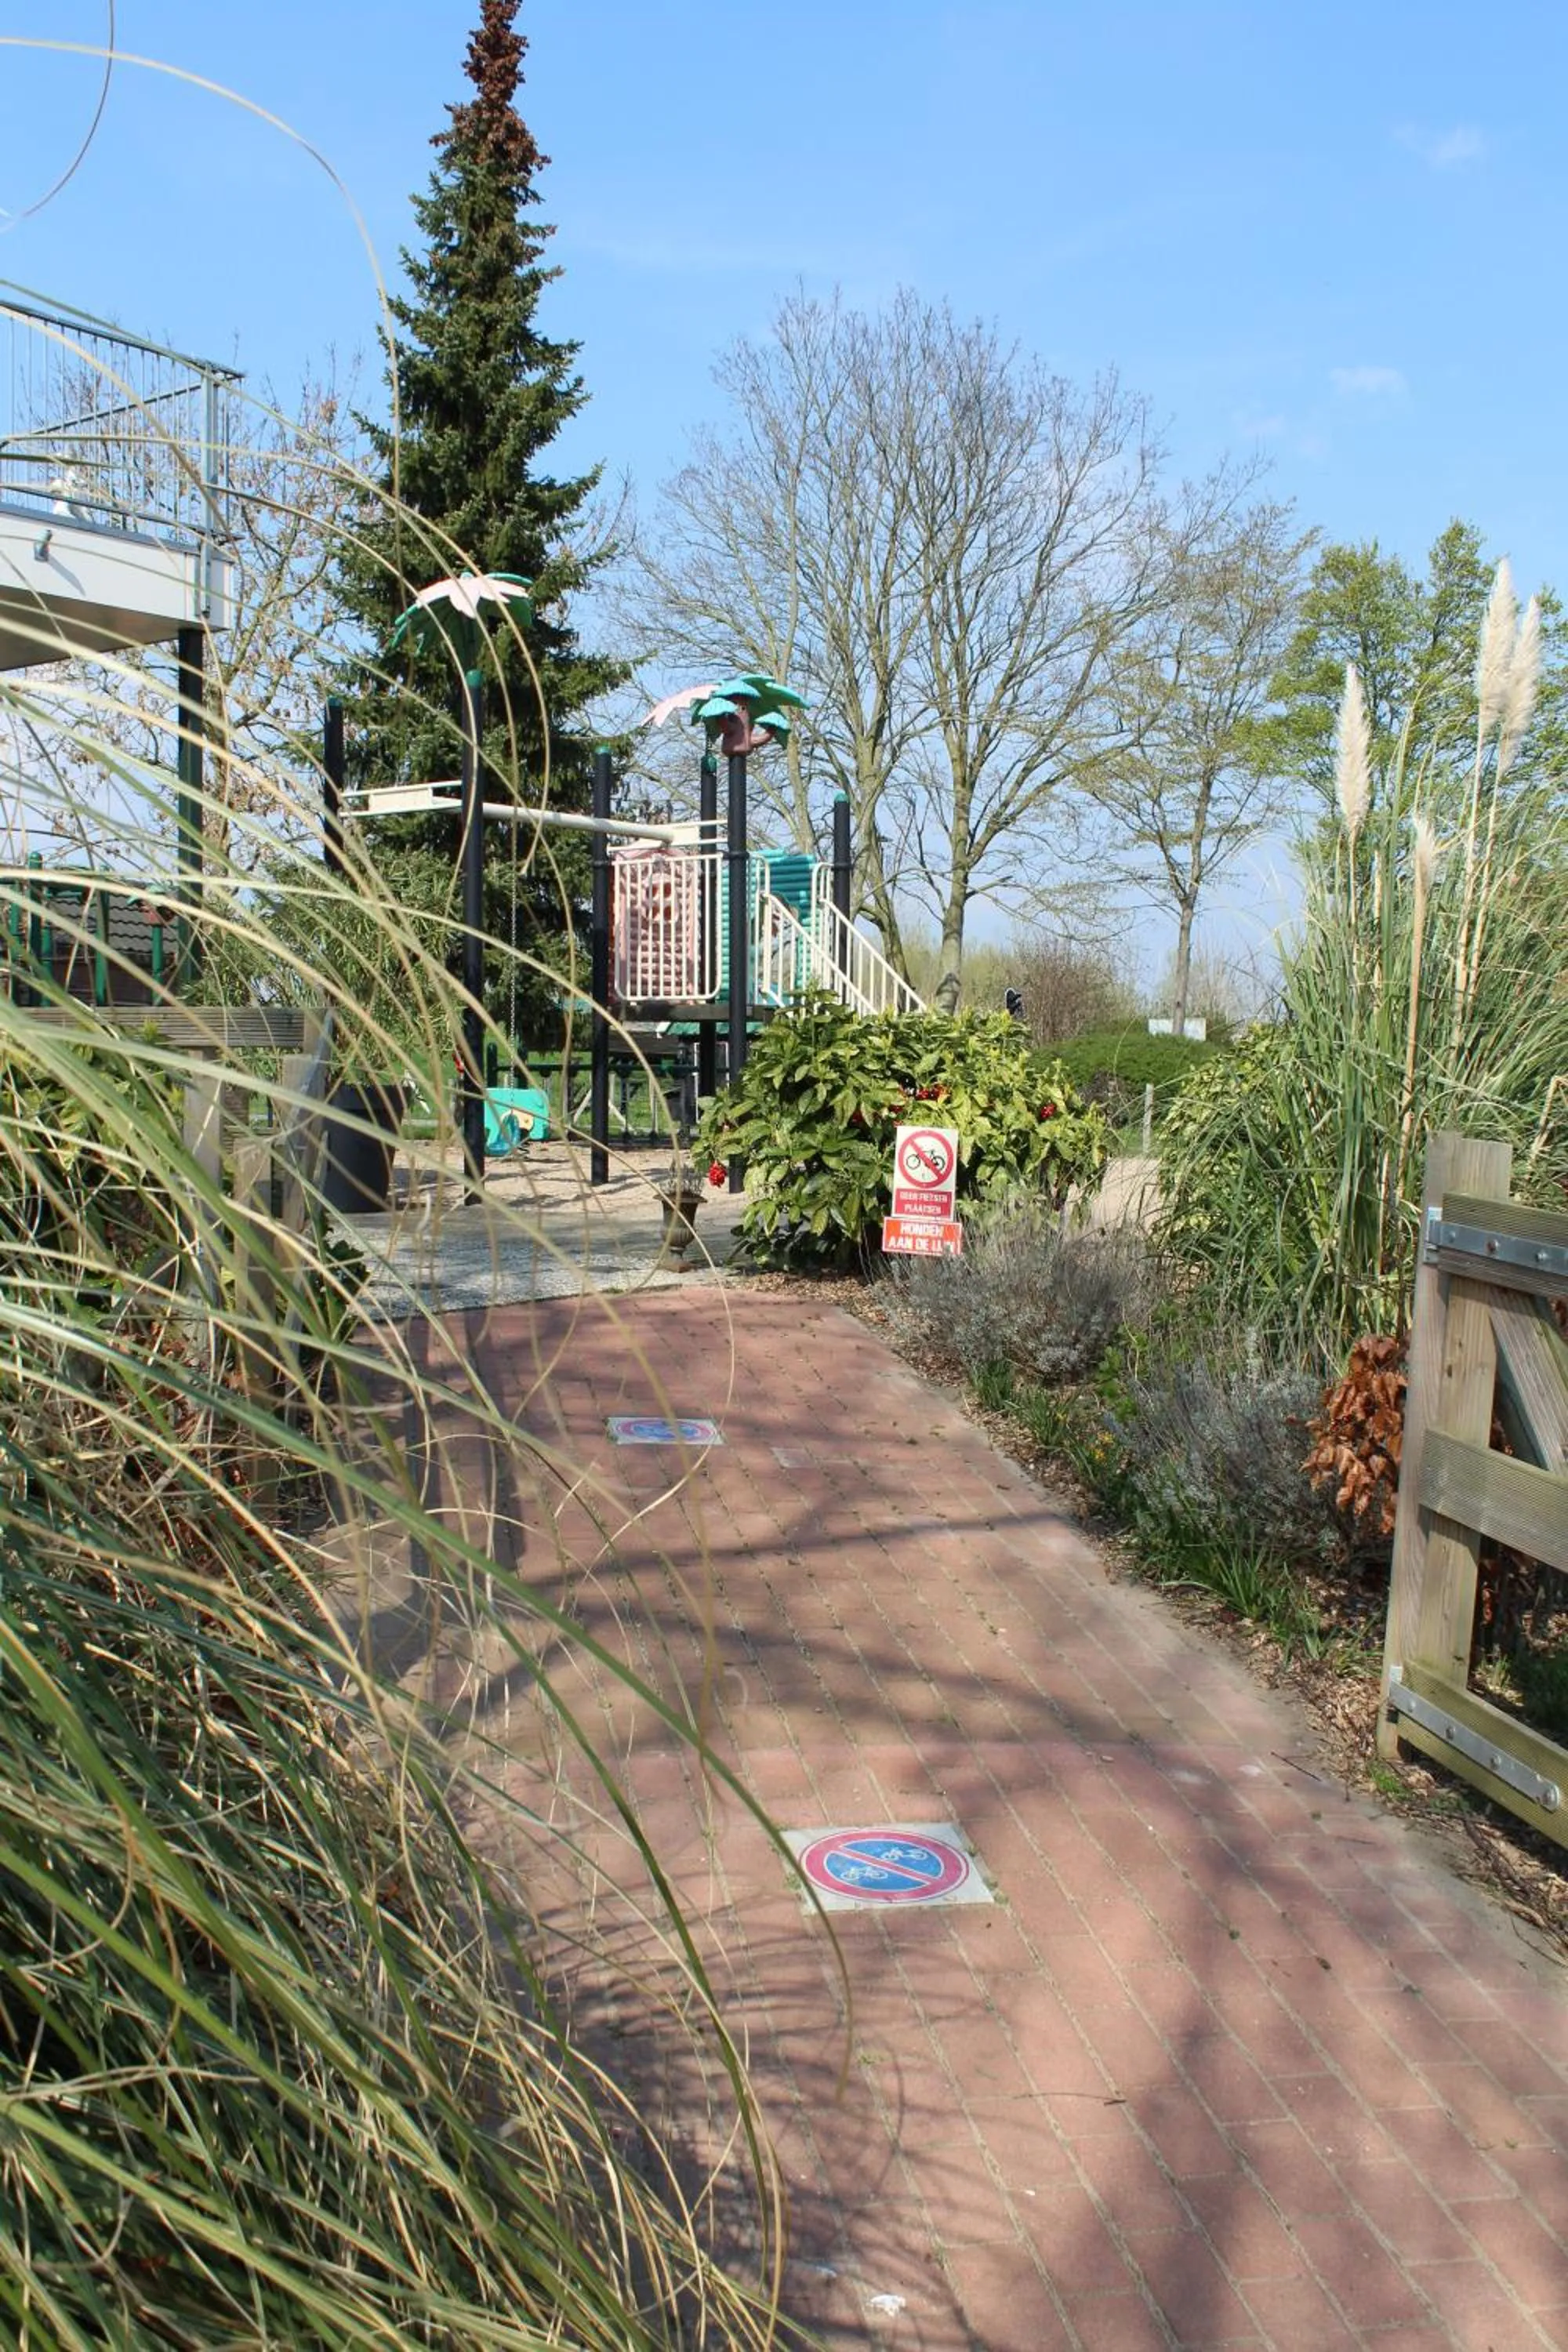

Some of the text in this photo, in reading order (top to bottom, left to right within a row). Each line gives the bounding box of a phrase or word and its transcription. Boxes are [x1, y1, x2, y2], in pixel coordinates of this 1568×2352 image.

[901, 1223, 943, 1237] HONDEN
[889, 1236, 913, 1248] AAN
[916, 1239, 928, 1250] DE
